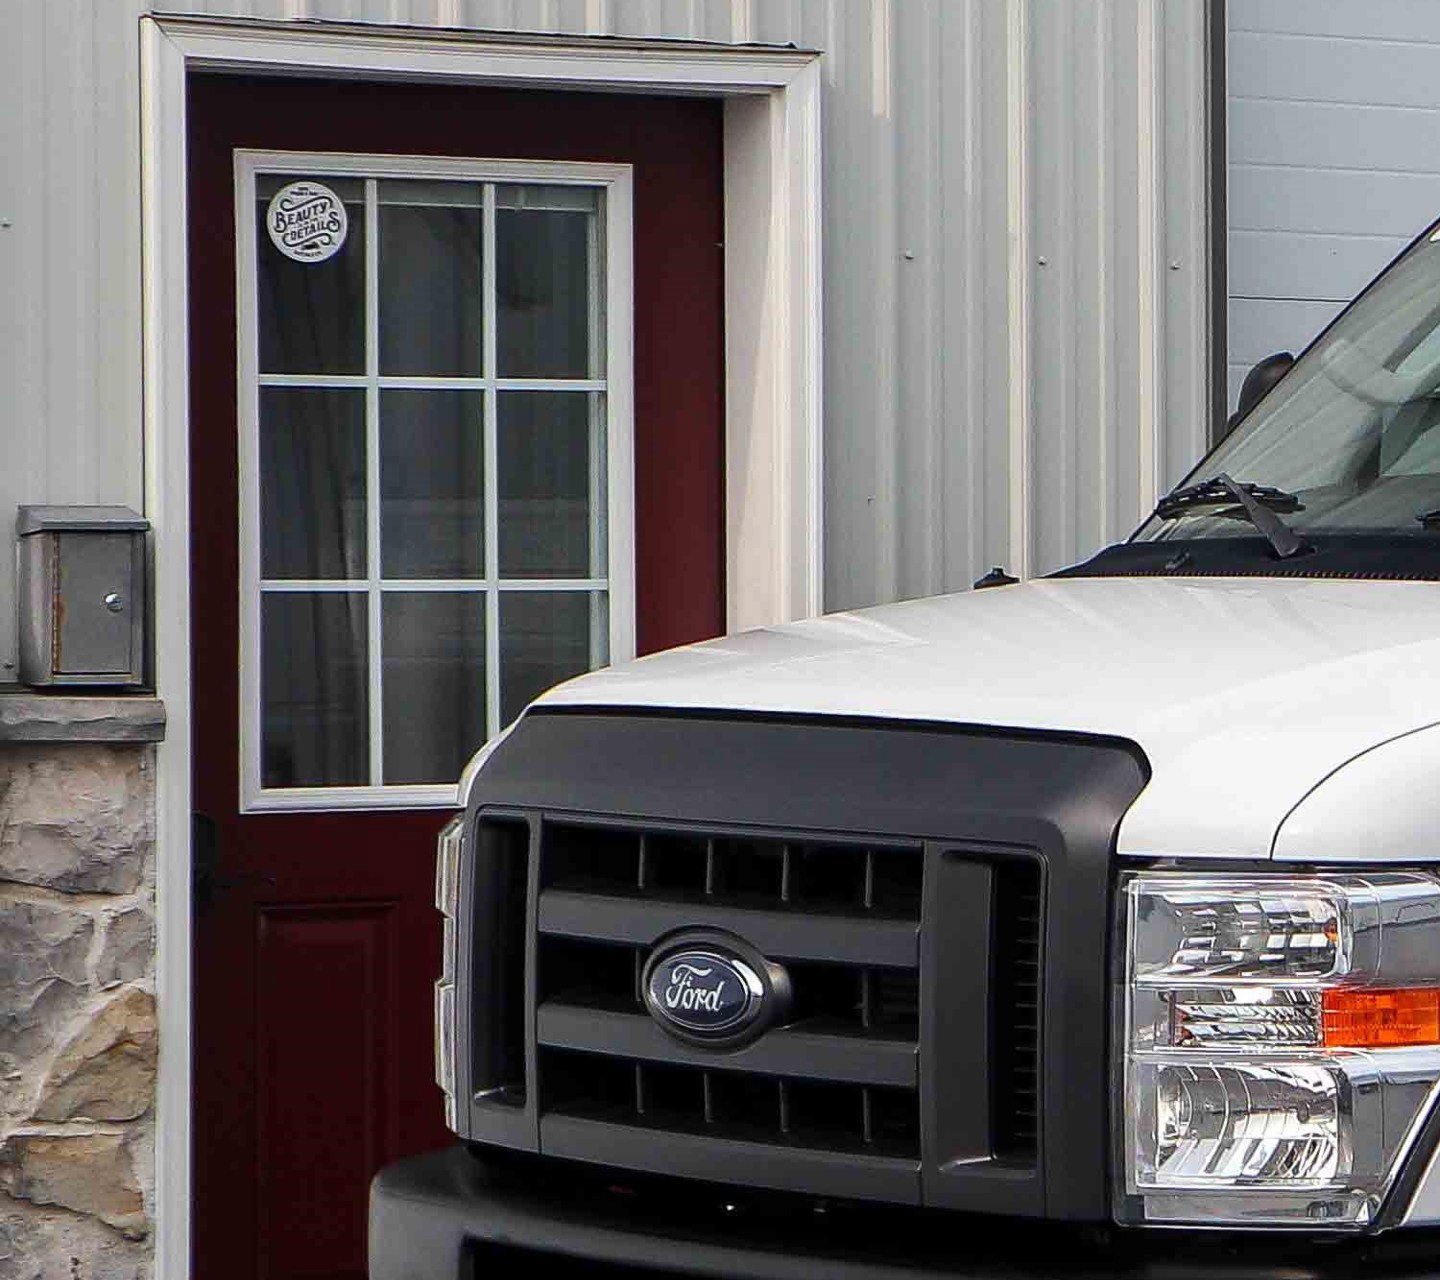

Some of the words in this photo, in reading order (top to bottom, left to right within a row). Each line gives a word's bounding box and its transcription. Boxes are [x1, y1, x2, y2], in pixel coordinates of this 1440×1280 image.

[274, 201, 327, 233] BEAUTY
[290, 212, 340, 241] DETAILS
[666, 963, 726, 1012] Ford
